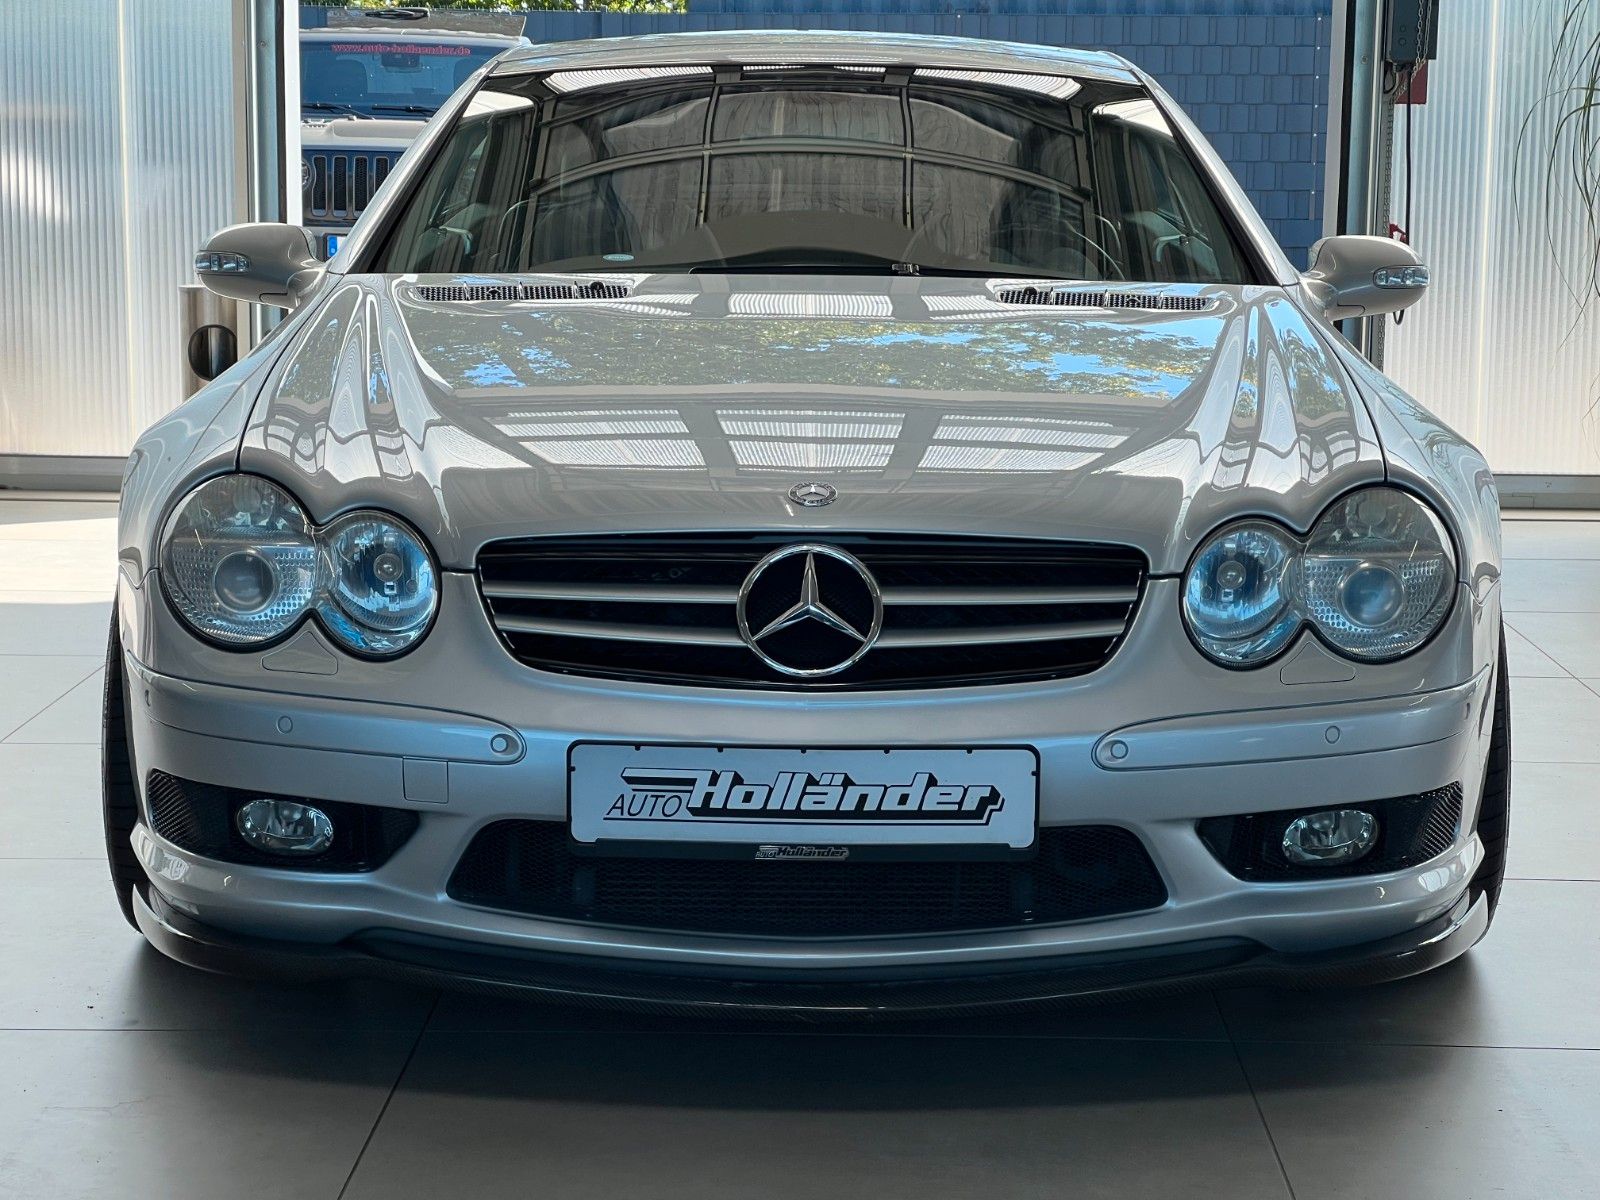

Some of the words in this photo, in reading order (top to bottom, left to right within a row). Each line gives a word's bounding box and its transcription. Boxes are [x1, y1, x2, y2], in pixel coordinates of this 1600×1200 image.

[606, 793, 682, 817] AUTO
[686, 769, 1001, 820] Holländer
[777, 845, 849, 860] Holländer
